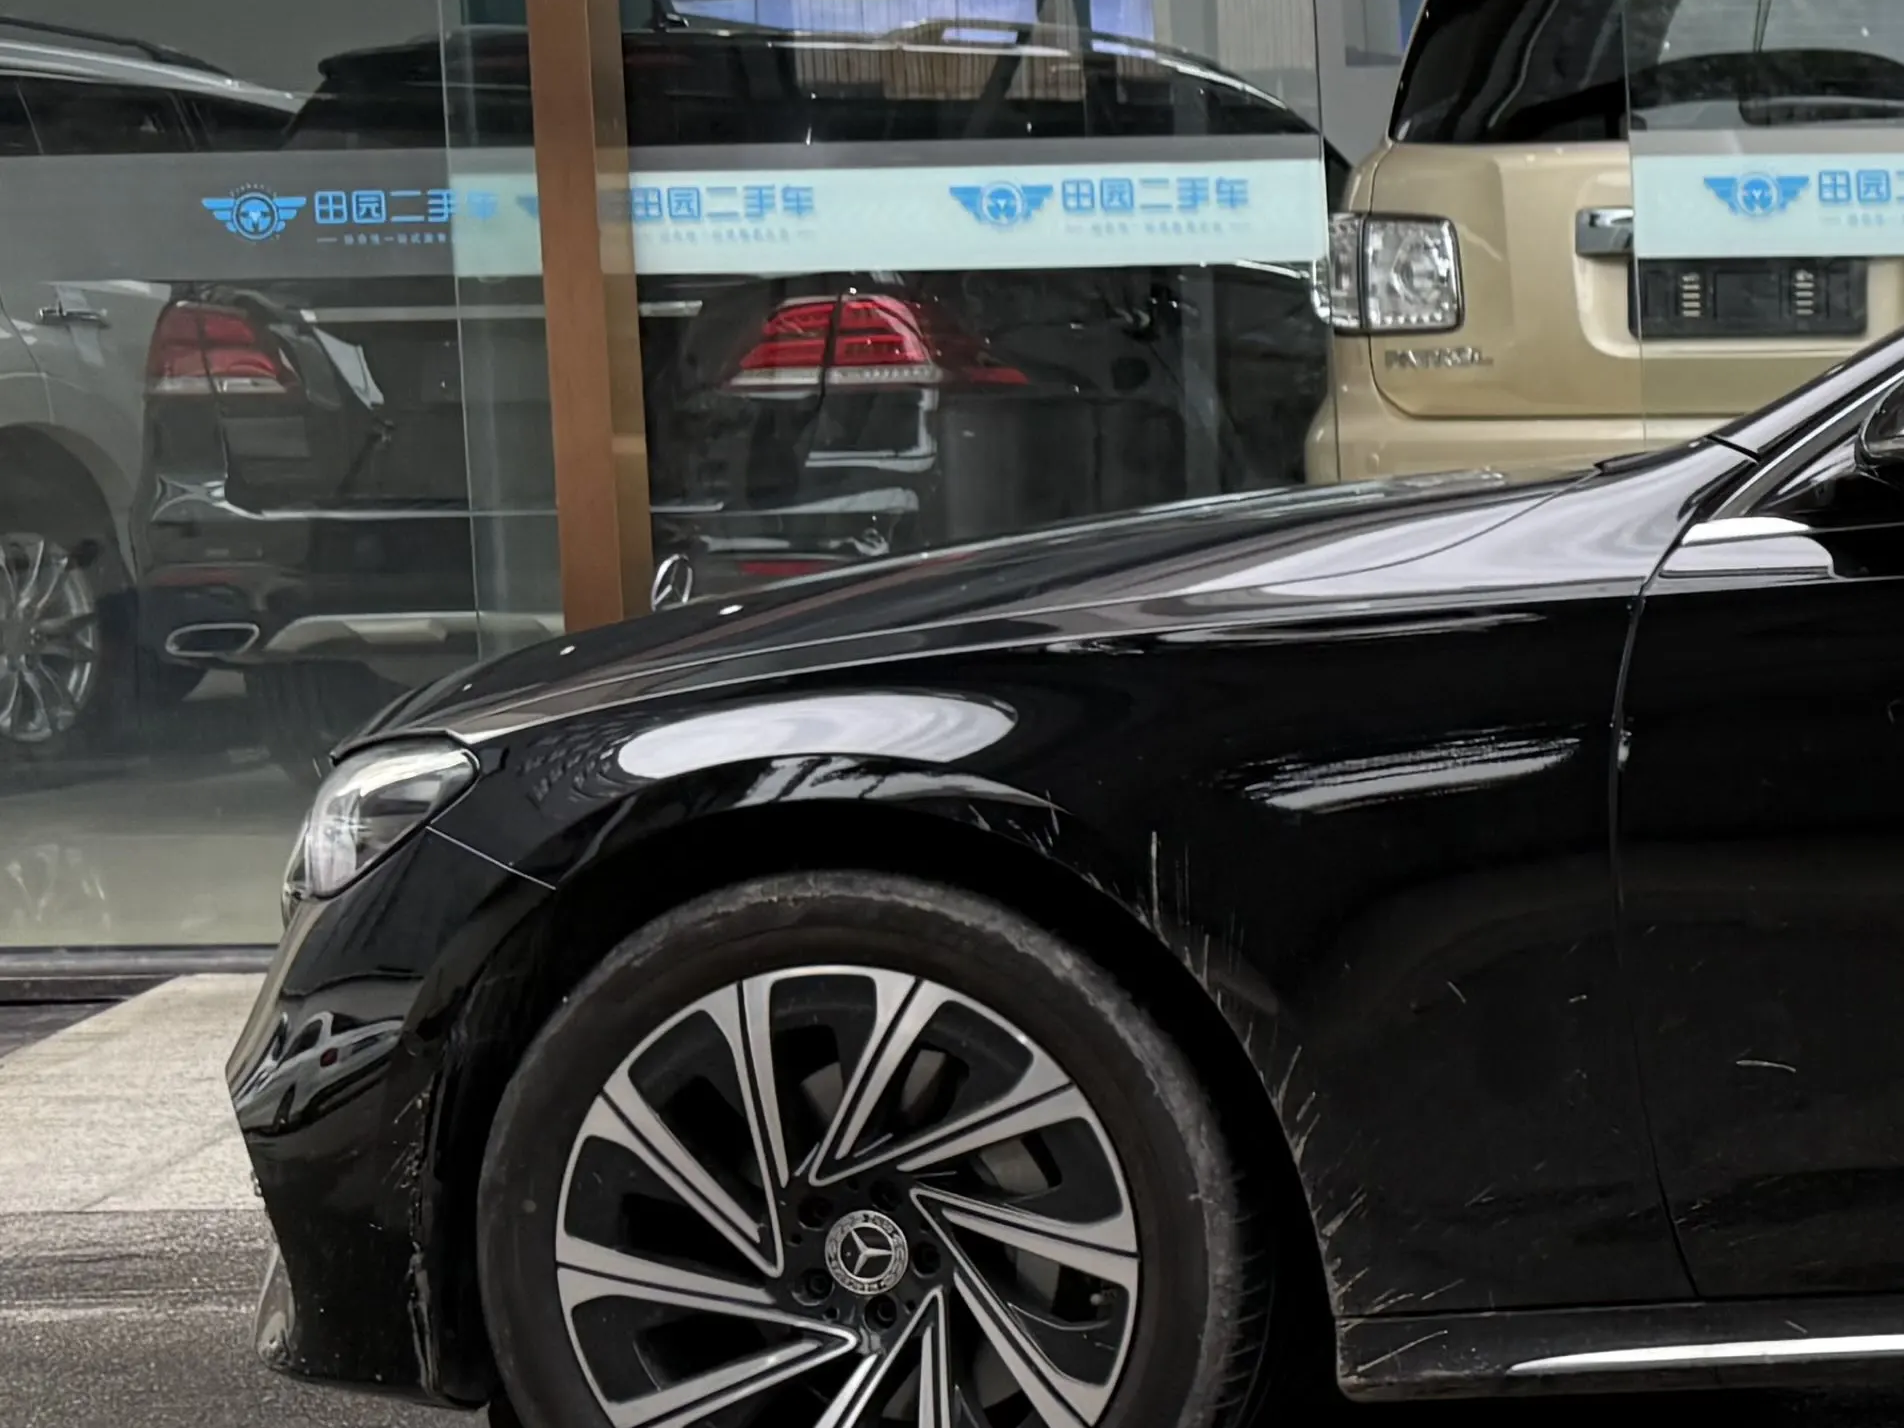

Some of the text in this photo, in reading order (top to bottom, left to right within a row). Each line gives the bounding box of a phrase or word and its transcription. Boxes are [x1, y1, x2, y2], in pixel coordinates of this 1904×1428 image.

[631, 184, 815, 222] 田园二手车
[1060, 177, 1250, 215] 田园二手车
